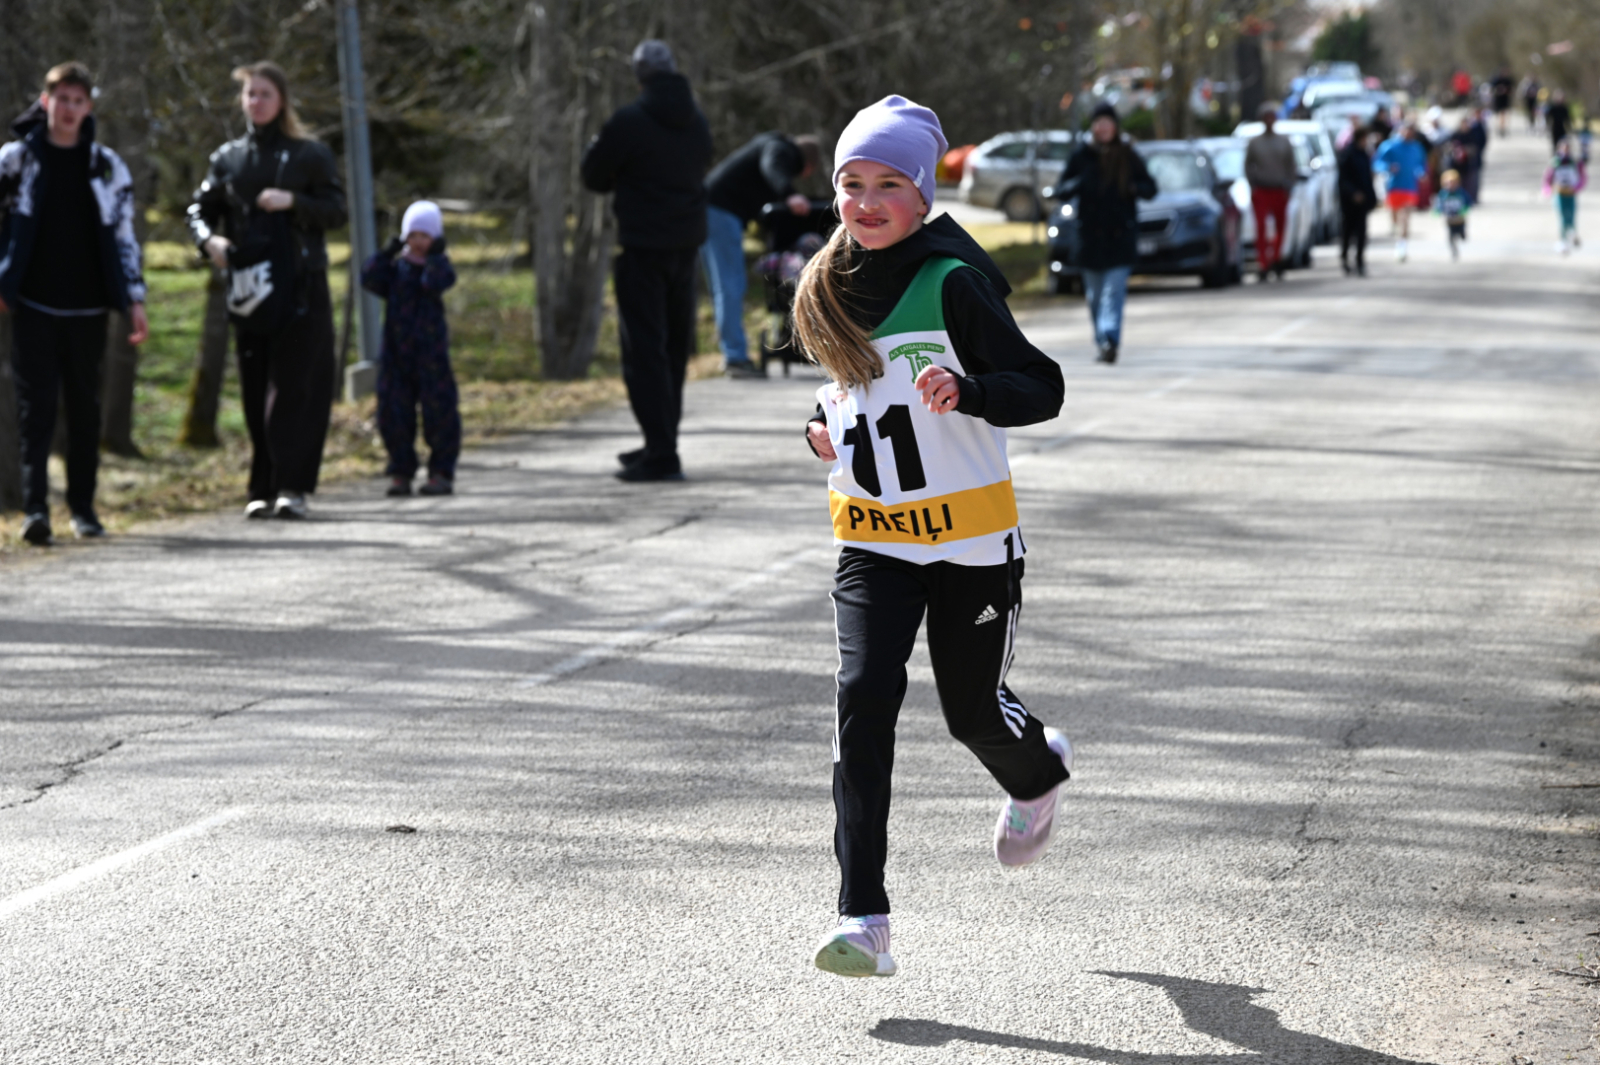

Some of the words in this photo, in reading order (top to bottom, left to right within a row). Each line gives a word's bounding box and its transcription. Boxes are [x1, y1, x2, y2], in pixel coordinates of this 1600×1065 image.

[900, 344, 926, 353] LATGALES
[843, 404, 927, 498] 11
[848, 503, 953, 541] PREIĻI
